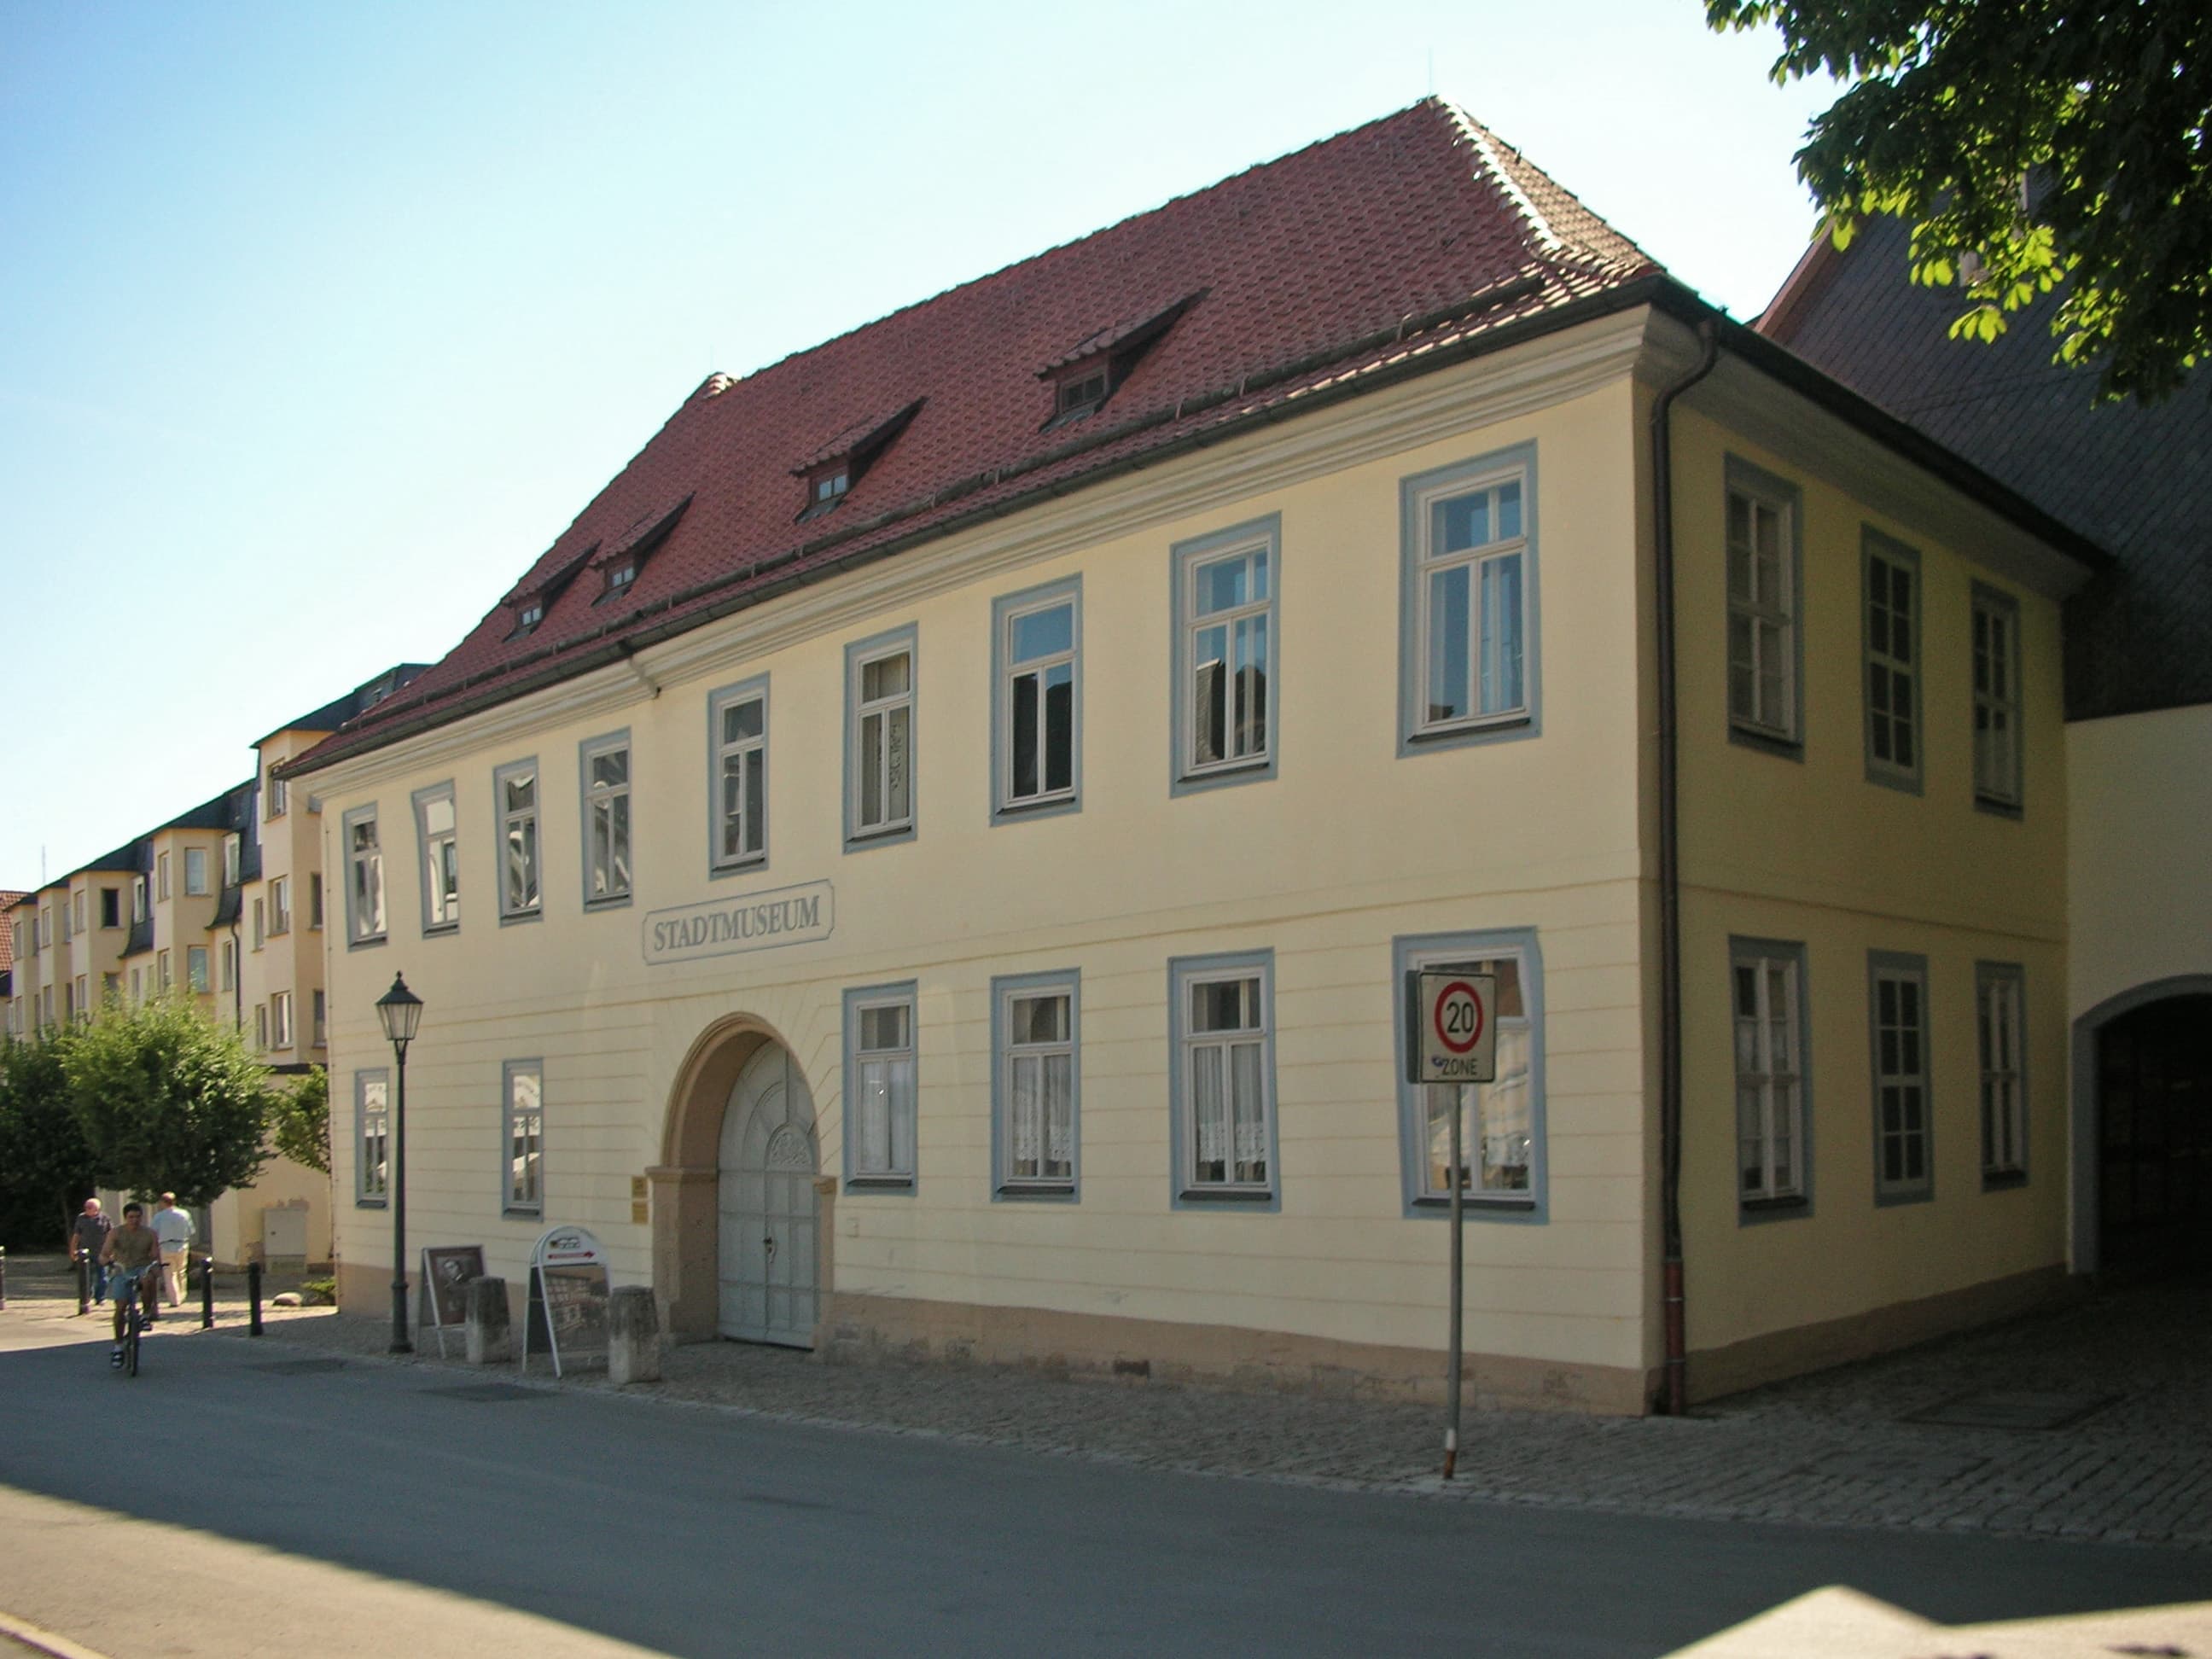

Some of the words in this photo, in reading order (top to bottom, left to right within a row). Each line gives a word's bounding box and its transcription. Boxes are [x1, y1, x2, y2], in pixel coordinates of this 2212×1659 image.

[654, 895, 820, 952] STADTMUSEUM
[1447, 1001, 1475, 1033] 20
[1441, 1058, 1478, 1076] ZONE
